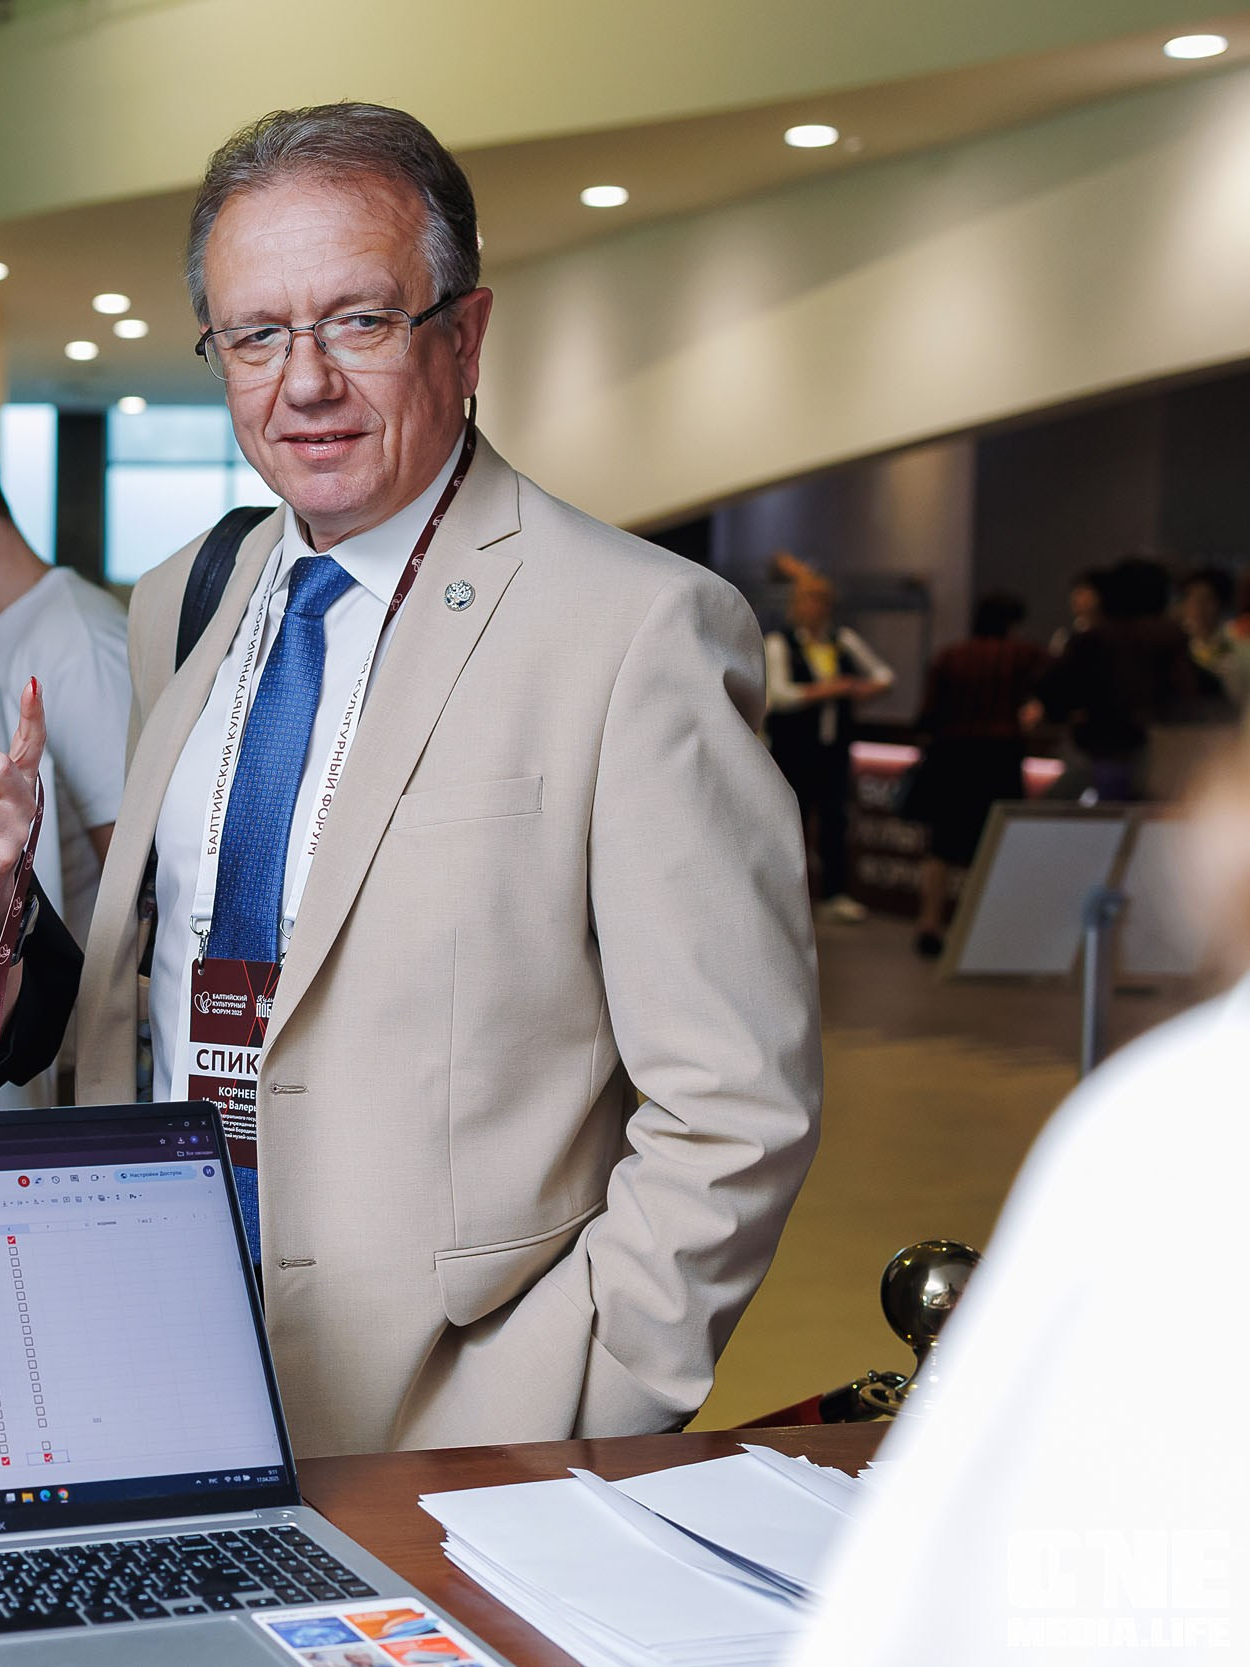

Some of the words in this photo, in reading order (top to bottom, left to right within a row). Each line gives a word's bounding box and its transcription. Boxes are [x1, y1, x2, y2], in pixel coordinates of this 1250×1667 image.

[325, 678, 363, 789] КУЛЬТУРНЫЙ
[207, 744, 233, 855] БАЛТИЙСКИЙ
[227, 639, 257, 741] КУЛЬТУРНЫЙ
[212, 993, 248, 1002] БАЛТИЙСКИЙ
[212, 1001, 246, 1009] КУЛЬТУРНЫЙ
[196, 1048, 260, 1075] СПИК
[218, 1086, 257, 1100] КОРНЕЕ
